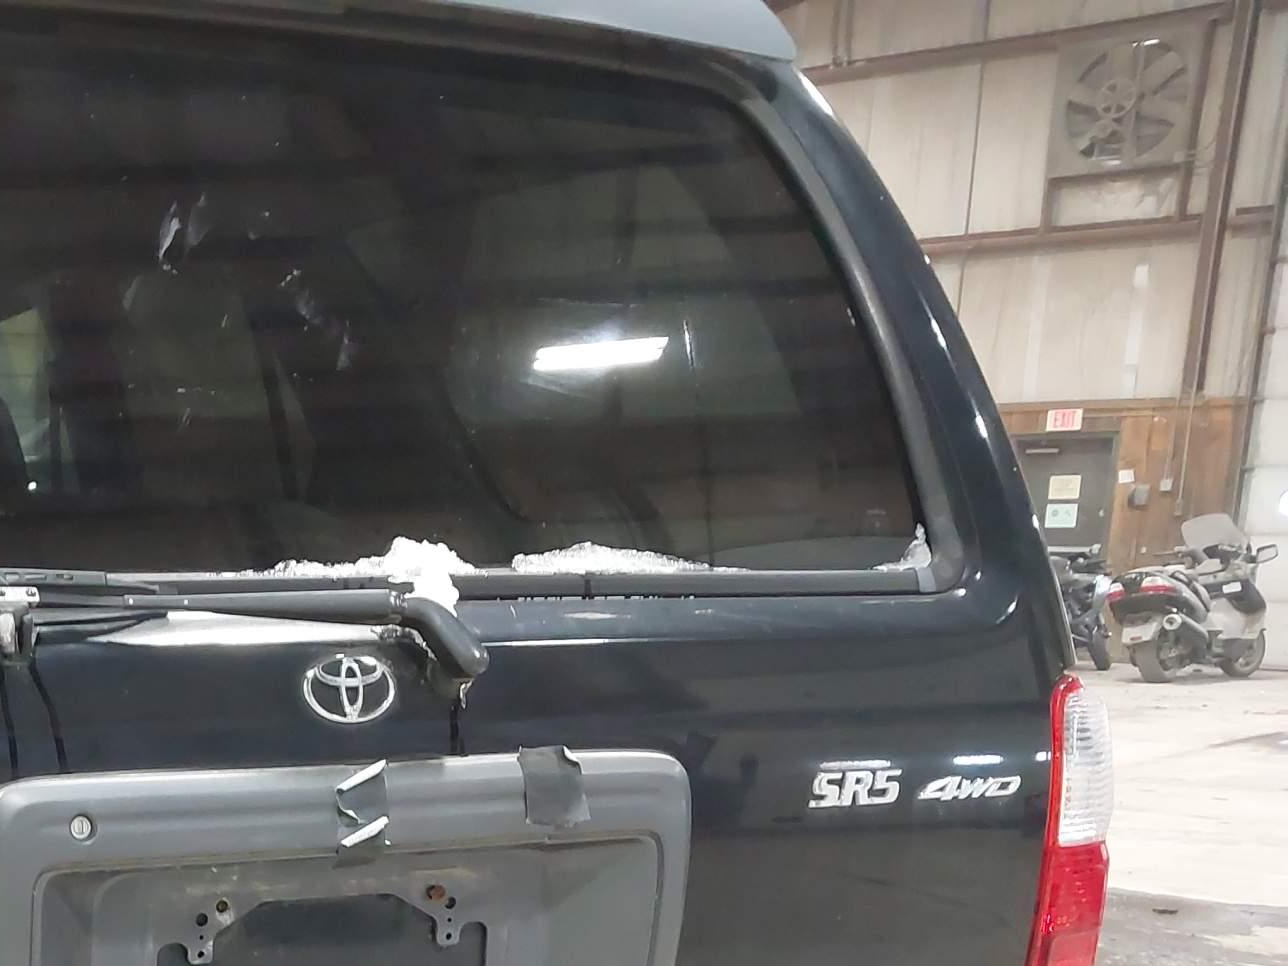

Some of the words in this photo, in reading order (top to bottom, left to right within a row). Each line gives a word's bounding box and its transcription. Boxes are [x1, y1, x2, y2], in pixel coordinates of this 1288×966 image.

[1052, 410, 1077, 429] EXIT
[808, 768, 902, 808] SR5
[917, 775, 1022, 801] 4WD
